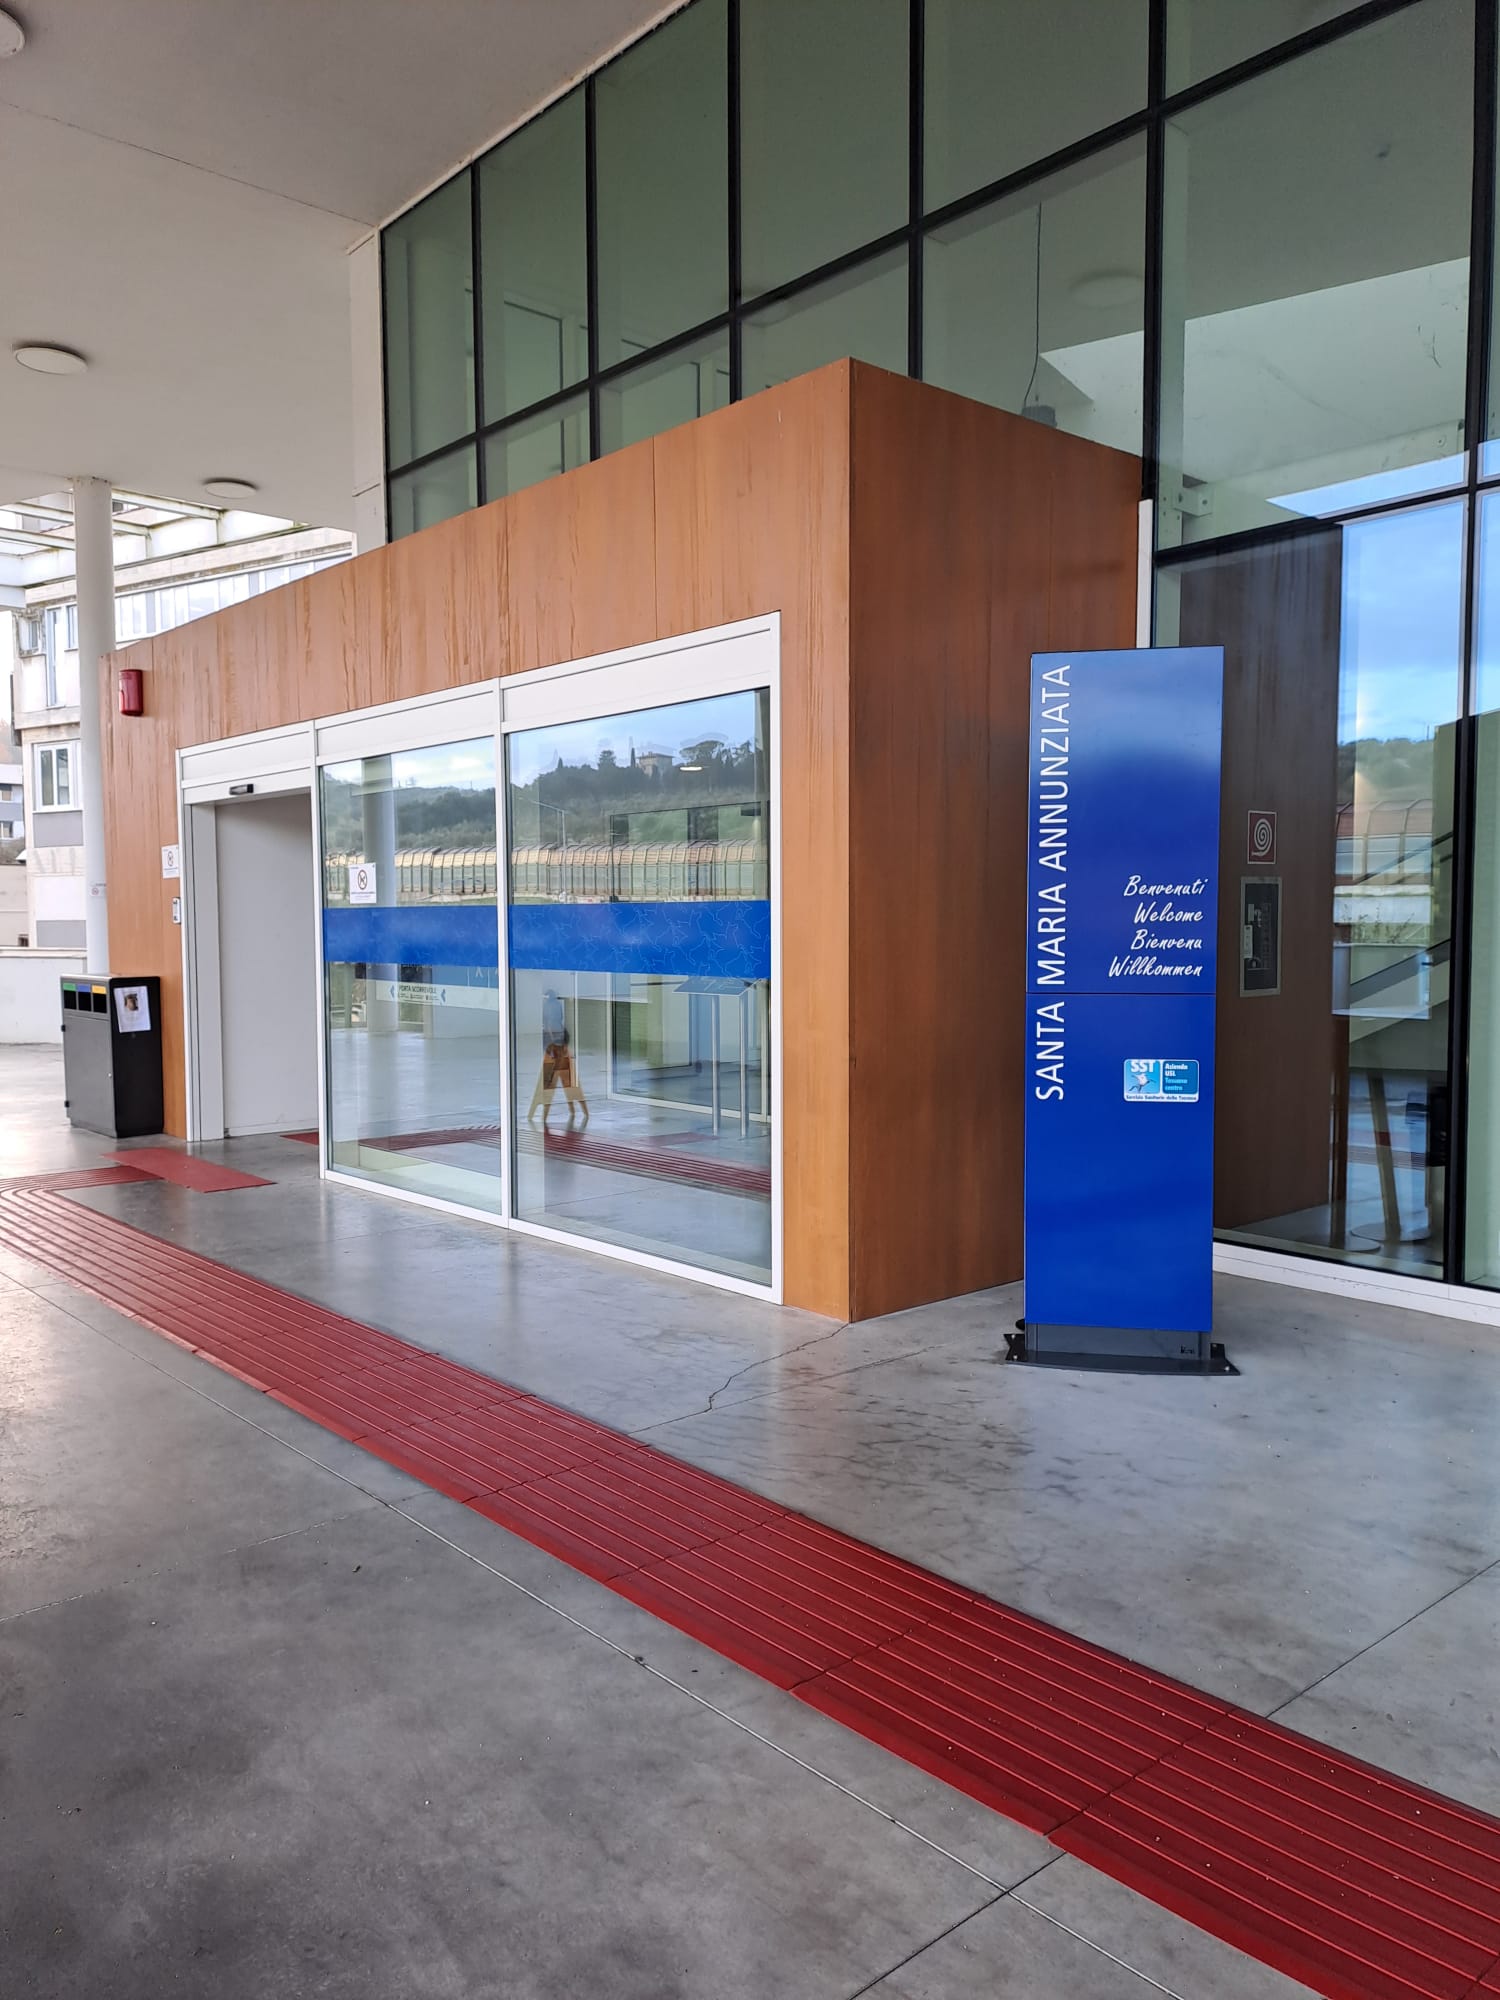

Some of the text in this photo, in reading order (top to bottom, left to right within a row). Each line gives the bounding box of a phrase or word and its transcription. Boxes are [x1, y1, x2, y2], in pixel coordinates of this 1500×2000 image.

[1035, 664, 1071, 1100] SANTA MARIA ANNUNZIATA
[1123, 874, 1208, 896] Benvenuti
[1133, 901, 1204, 924] Welcome
[1130, 928, 1203, 950] Bienvenu
[1108, 955, 1204, 978] Willkommen
[1130, 1060, 1156, 1073] SST
